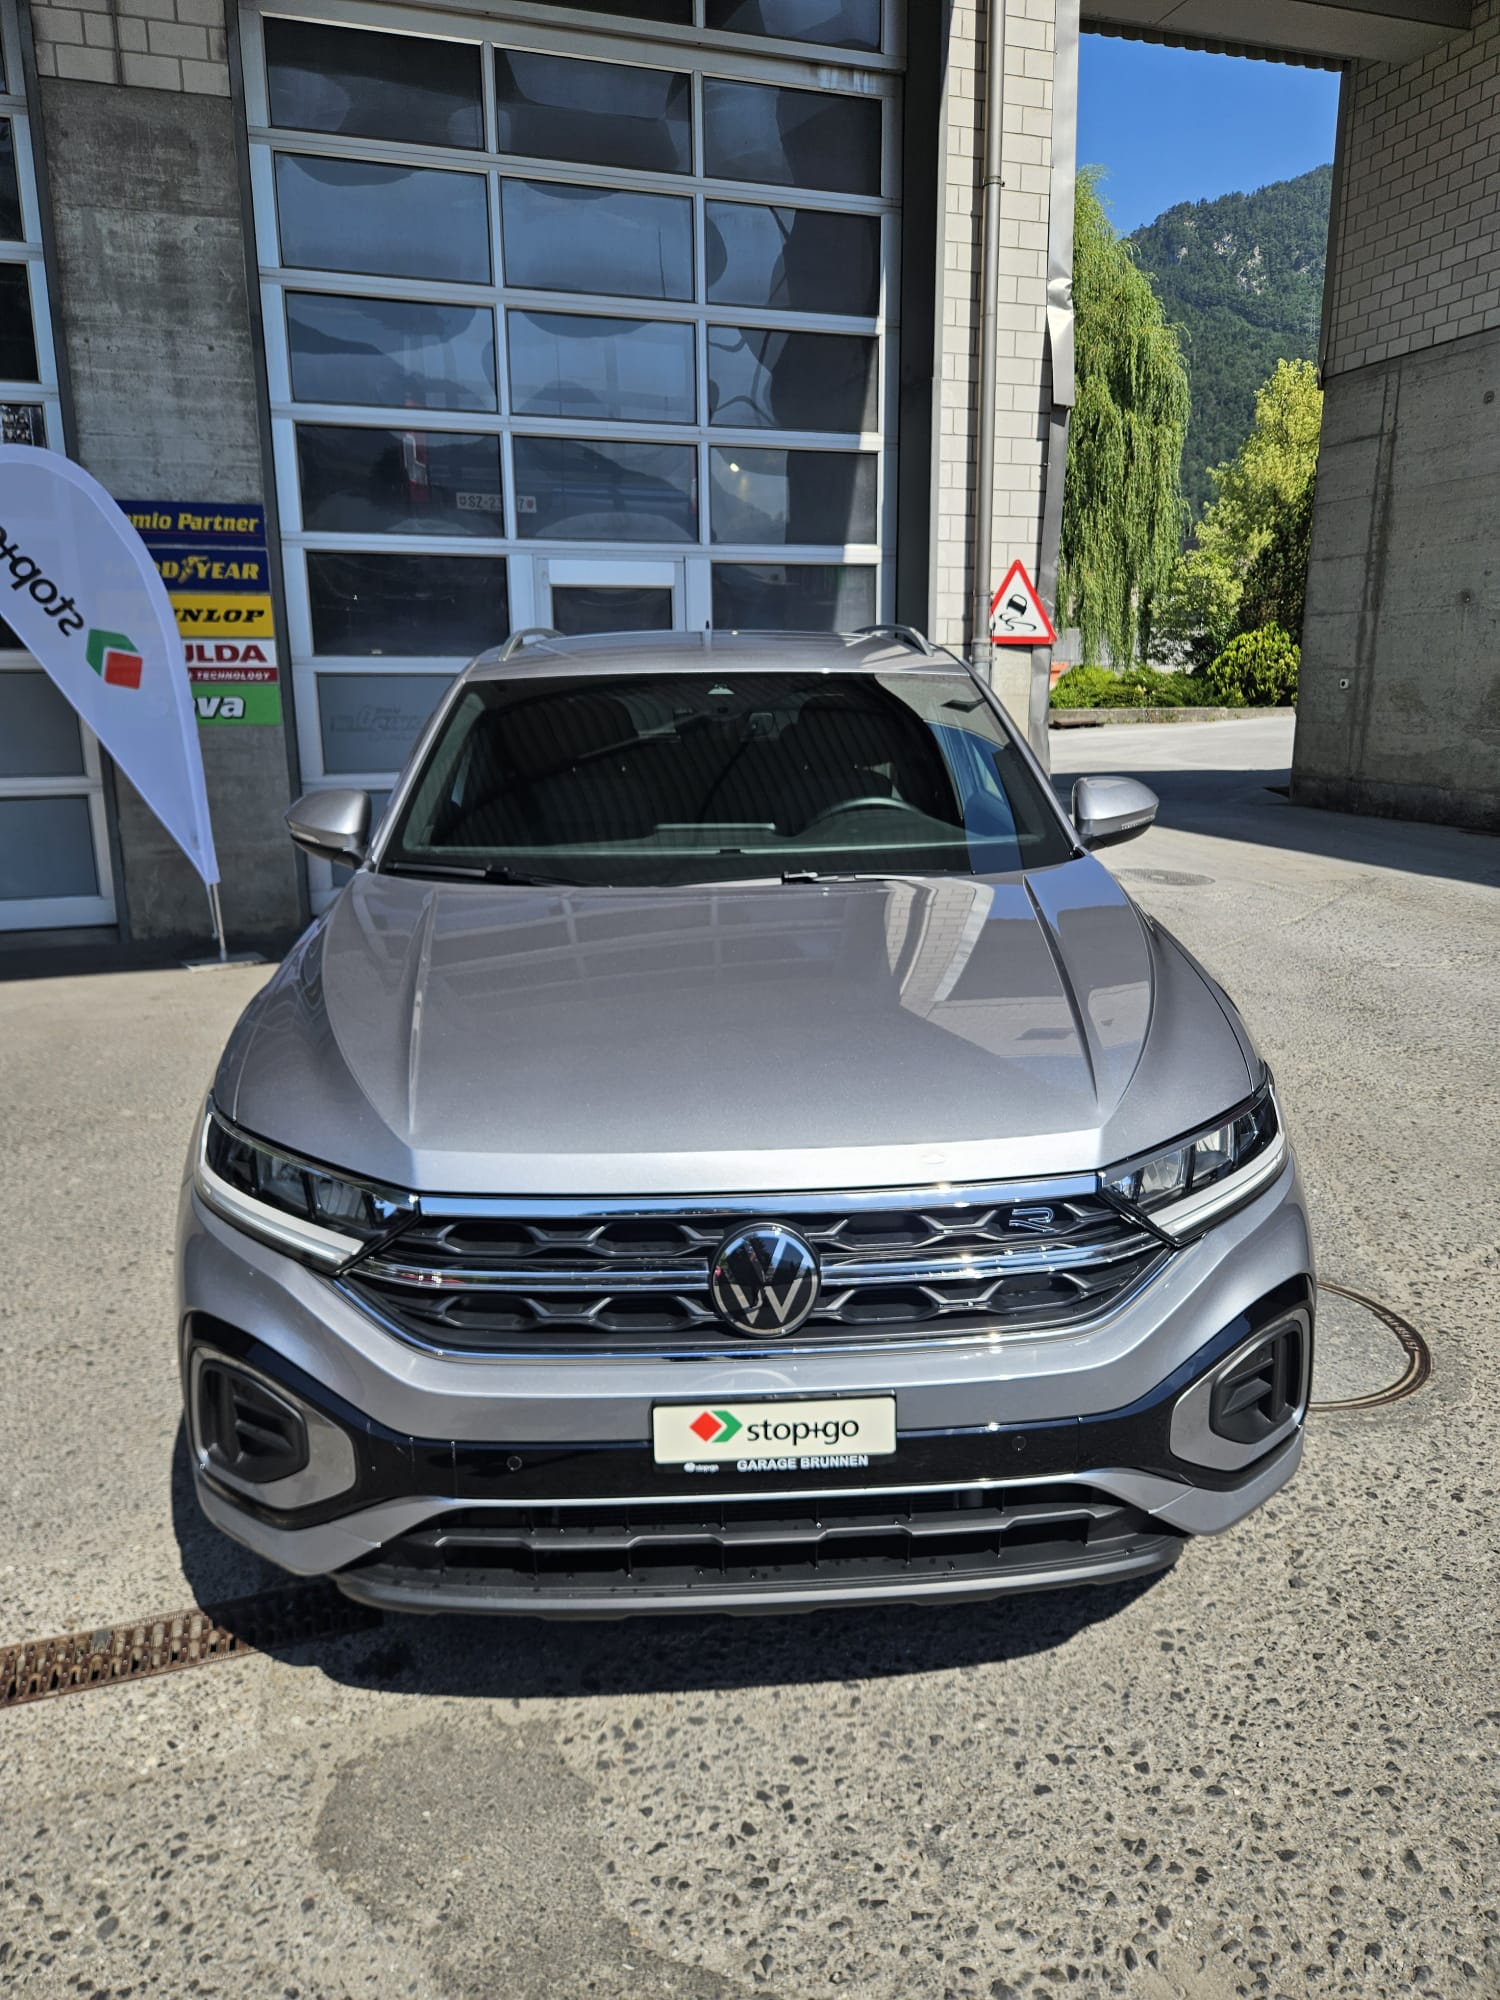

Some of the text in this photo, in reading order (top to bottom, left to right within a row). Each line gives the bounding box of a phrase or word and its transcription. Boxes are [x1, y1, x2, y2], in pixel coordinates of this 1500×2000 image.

[128, 512, 259, 532] mio Partner
[197, 671, 270, 681] TECHNOLOGY
[192, 696, 245, 718] va
[746, 1419, 860, 1446] stop+go
[736, 1455, 869, 1473] GARAGE BRUNNEN
